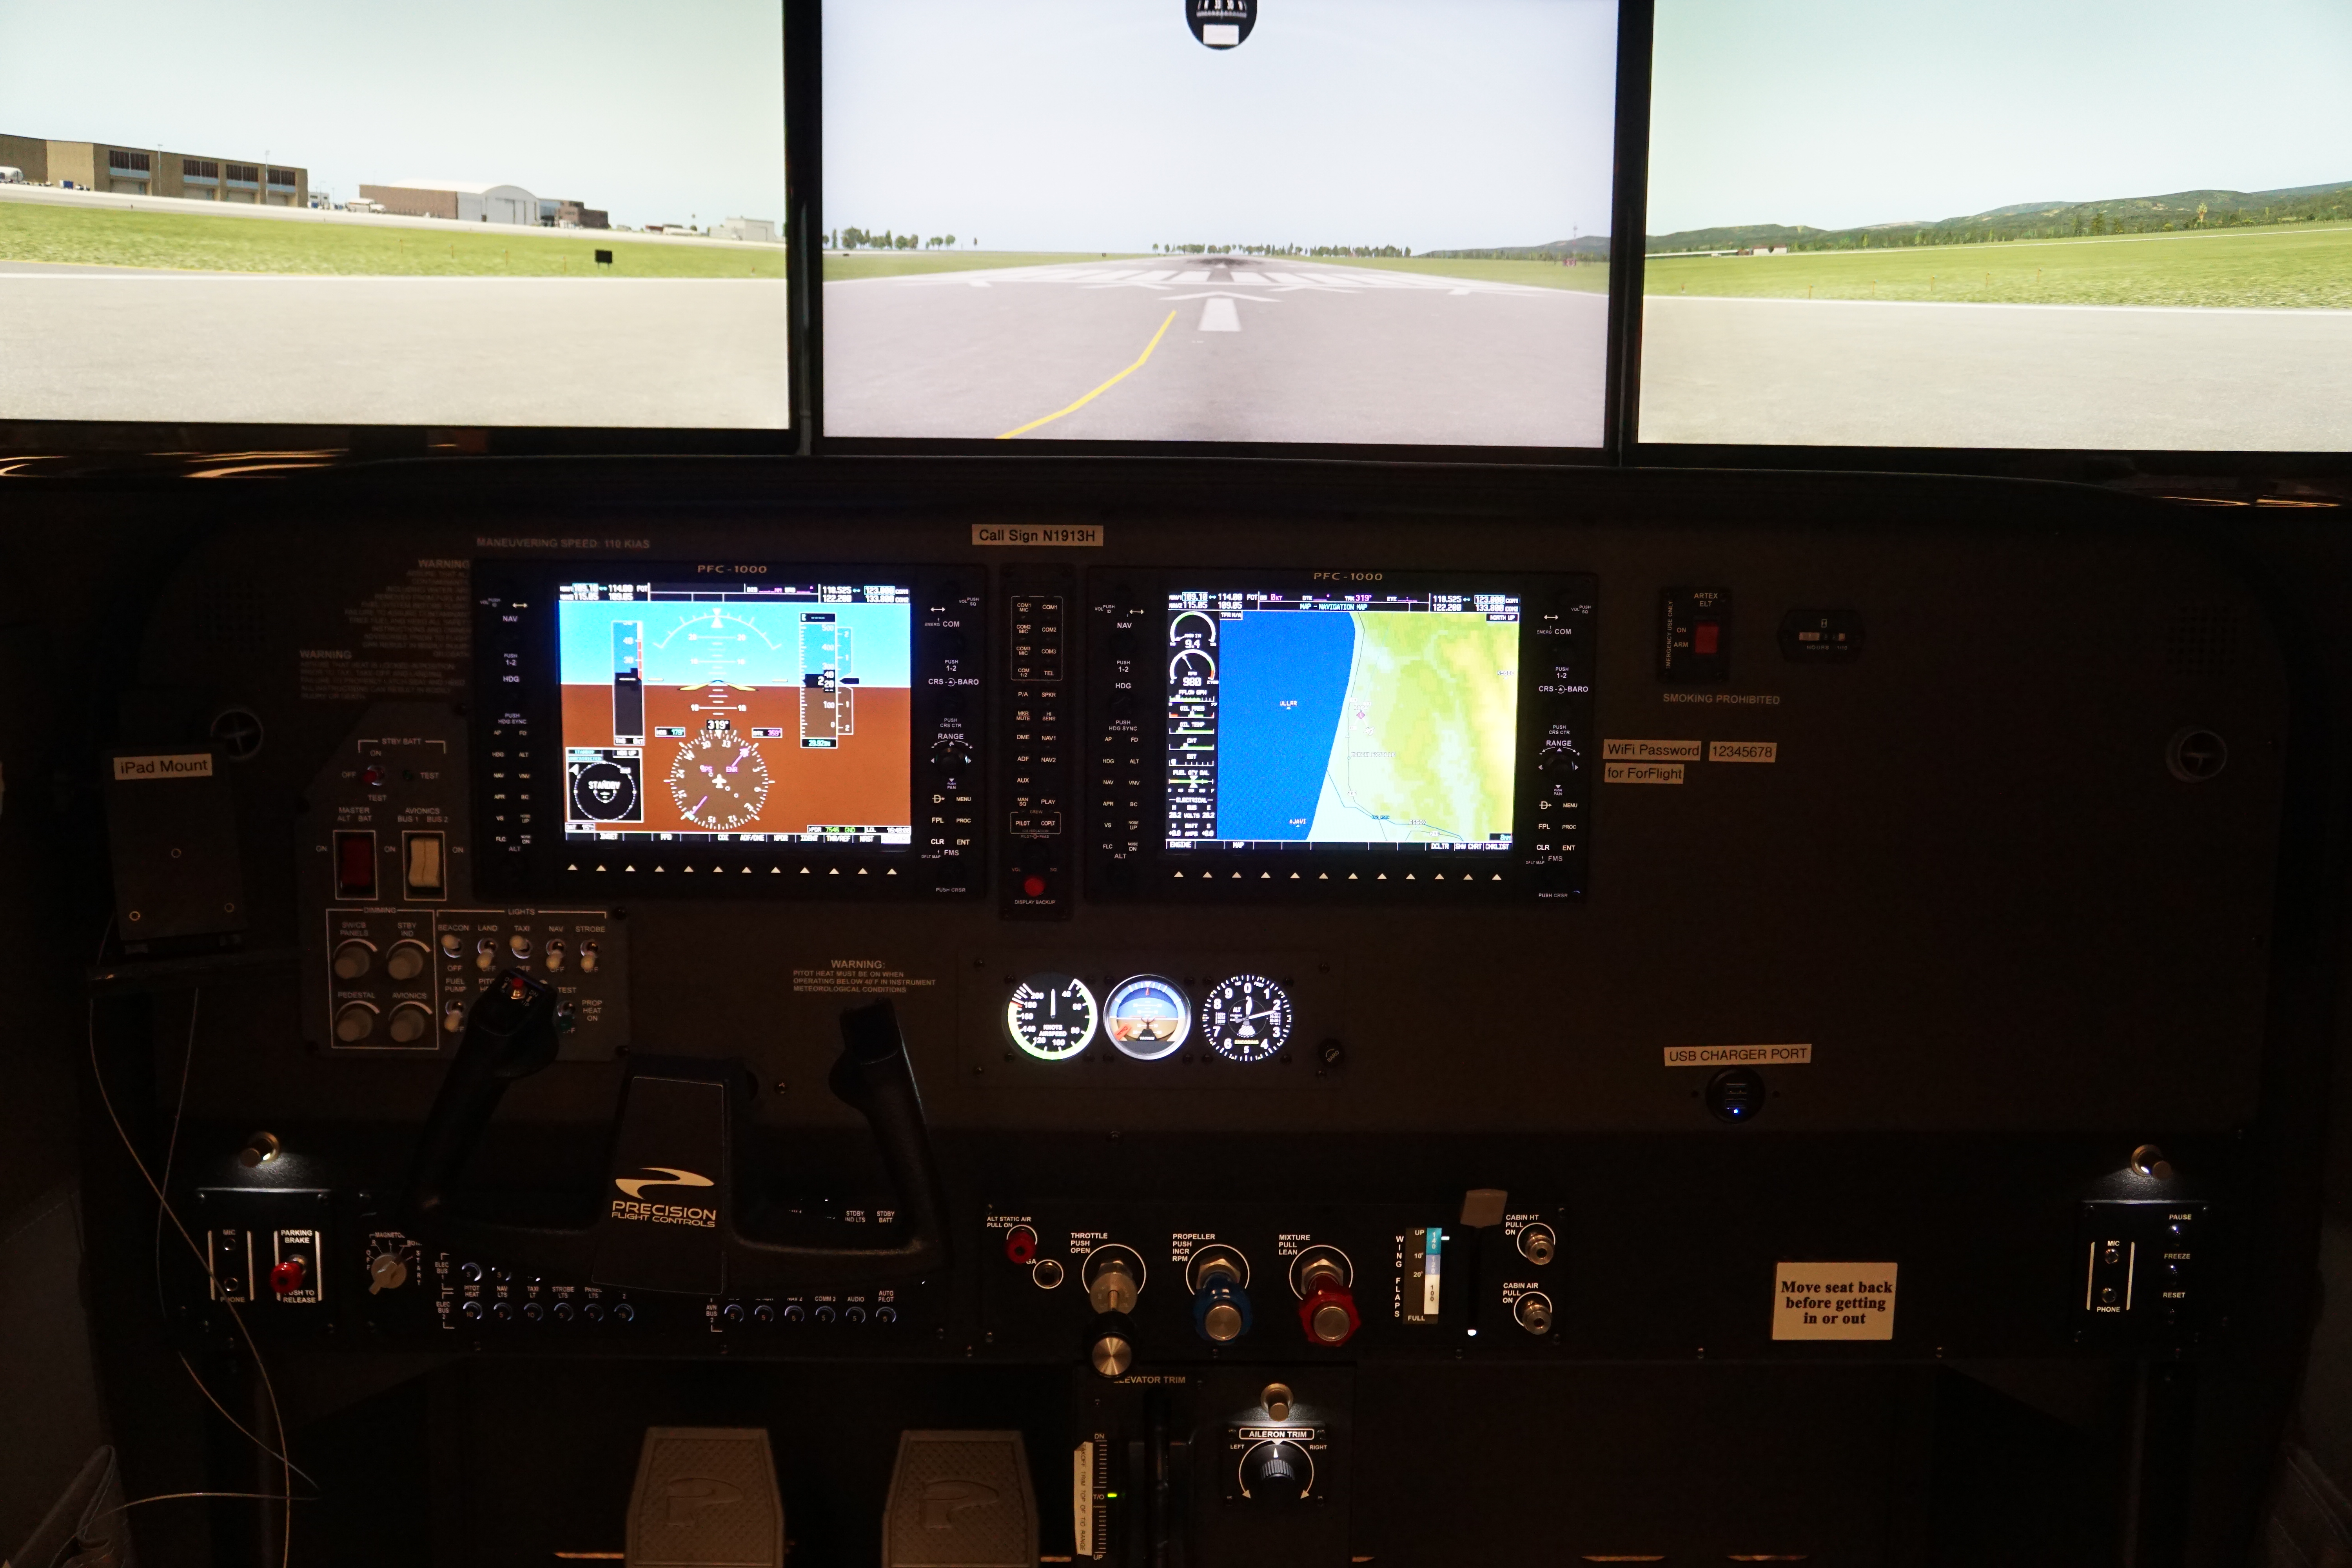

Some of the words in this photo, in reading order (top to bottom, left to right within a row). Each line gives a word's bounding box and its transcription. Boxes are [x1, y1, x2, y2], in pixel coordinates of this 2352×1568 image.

[980, 530, 1004, 540] Call
[1009, 530, 1038, 543] Sign
[1043, 530, 1095, 541] N1913H
[476, 537, 558, 548] MANEUVERING
[604, 539, 621, 549] 110
[624, 539, 650, 549] KIAS
[418, 559, 469, 569] WARNING
[1185, 640, 1200, 648] 9.4
[300, 650, 352, 659] WARNING
[1183, 678, 1201, 686] 980
[1663, 693, 1713, 703] SMOKING
[1715, 694, 1781, 705] PROHIBITED
[1608, 744, 1635, 755] WiFi
[1639, 744, 1700, 757] Password
[1712, 745, 1773, 758] 12345678
[120, 761, 155, 774] iPad
[160, 759, 208, 772] Mount
[1607, 767, 1624, 778] for
[1627, 767, 1682, 780] ForFlight
[831, 960, 886, 969] WARNING:
[1670, 1051, 1697, 1062] USB
[1700, 1049, 1766, 1061] CHARGER
[1771, 1048, 1808, 1059] PORT
[612, 1200, 717, 1221] PRECISION
[612, 1212, 650, 1222] FLIGHT
[652, 1216, 716, 1228] CONTROLS
[1780, 1281, 1821, 1293] Move
[1825, 1282, 1854, 1293] seat
[1858, 1281, 1893, 1293] back
[1786, 1297, 1831, 1309] before
[1835, 1297, 1886, 1312] getting
[1803, 1312, 1817, 1324] in
[1822, 1314, 1838, 1324] or
[1842, 1313, 1866, 1324] out
[1113, 1376, 1161, 1384] EVATOR
